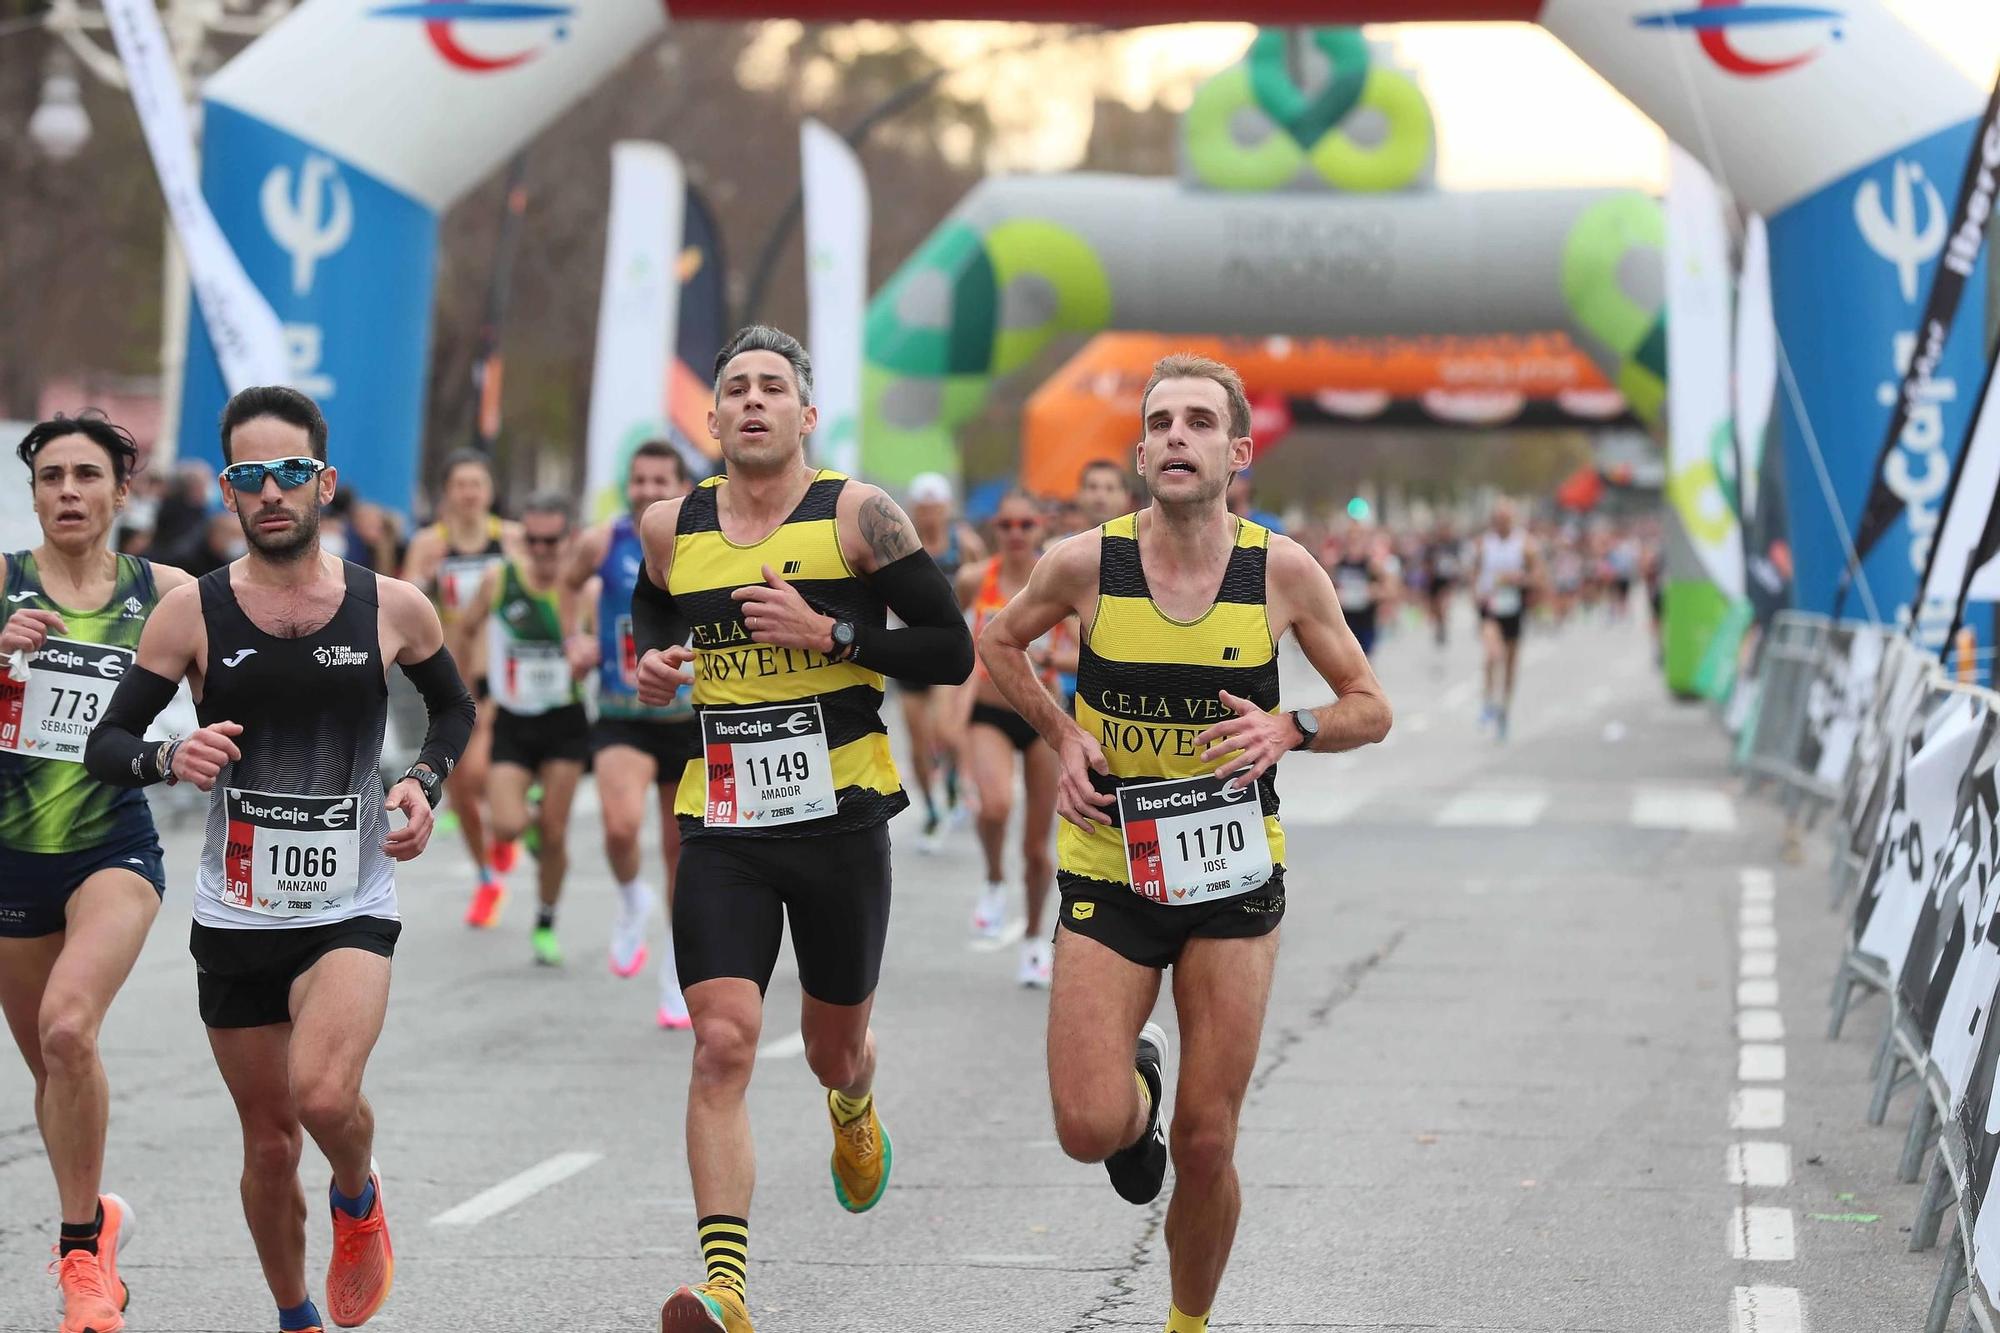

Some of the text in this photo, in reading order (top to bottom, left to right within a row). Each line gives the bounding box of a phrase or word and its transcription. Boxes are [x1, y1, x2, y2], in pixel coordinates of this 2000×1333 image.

[33, 649, 84, 668] erCaja
[333, 658, 367, 666] SUPPORT
[50, 687, 99, 722] 773
[715, 720, 773, 737] iberCaja
[746, 751, 810, 787] 1149
[761, 785, 801, 800] AMADOR
[1136, 789, 1207, 812] iberCaja
[240, 801, 309, 825] iberCaja
[716, 800, 732, 817] 01
[770, 806, 795, 818] 226ERS
[1176, 820, 1245, 862] 1170
[268, 844, 337, 877] 1066
[1203, 858, 1228, 873] JOSE
[234, 880, 248, 898] 01
[277, 879, 327, 892] MANZANO
[1144, 880, 1160, 897] 01
[1206, 879, 1231, 893] 226ERS
[287, 900, 312, 910] 226ERS
